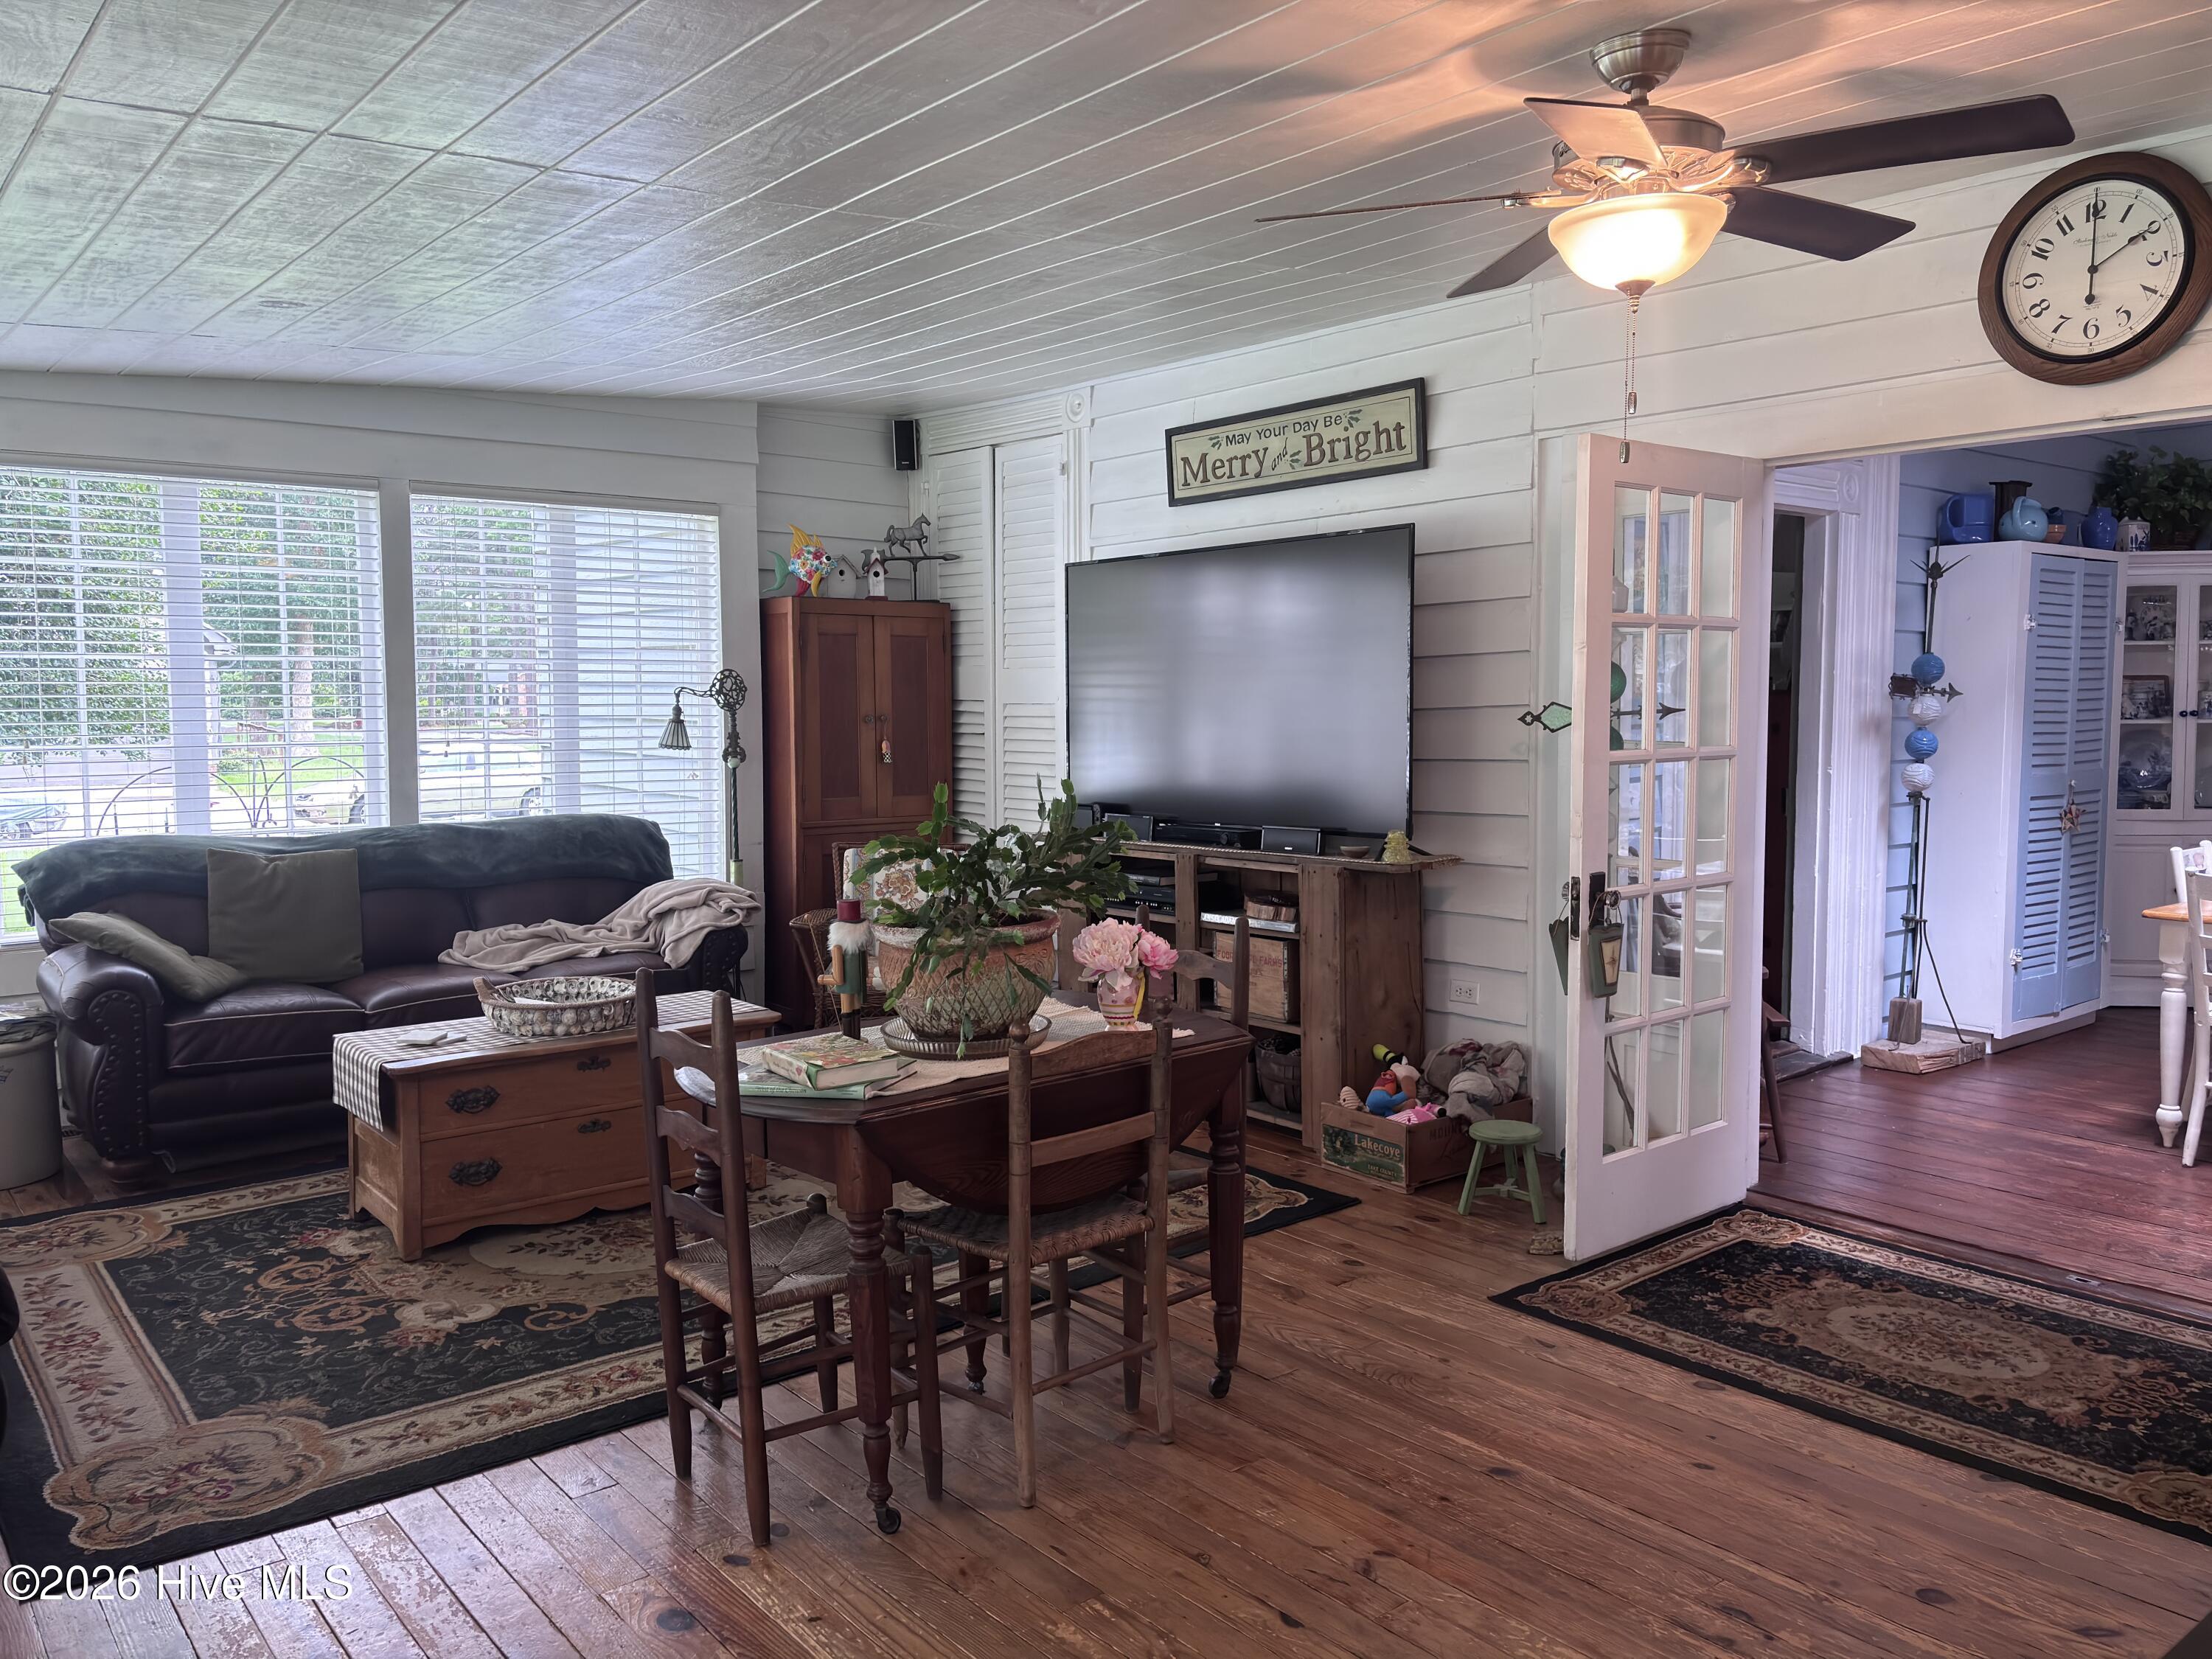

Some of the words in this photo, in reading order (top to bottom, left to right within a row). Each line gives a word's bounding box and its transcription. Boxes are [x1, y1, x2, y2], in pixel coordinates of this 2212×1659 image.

[2084, 199, 2107, 223] 12
[2118, 203, 2135, 224] 1
[2055, 213, 2075, 237] 11
[2136, 220, 2161, 242] 2
[2031, 237, 2055, 261] 10
[2146, 250, 2168, 267] 3
[2022, 272, 2045, 290] 9
[2140, 283, 2160, 302] 4
[2028, 298, 2051, 319] 8
[2115, 305, 2132, 327] 5
[2051, 314, 2073, 334] 7
[2083, 317, 2100, 340] 6
[1225, 432, 1252, 447] May
[1256, 425, 1289, 441] Your
[1293, 418, 1319, 434] Day
[1324, 414, 1343, 428] Be
[1180, 447, 1268, 487] Merry
[1271, 437, 1289, 472] and
[1302, 420, 1407, 467] Bright
